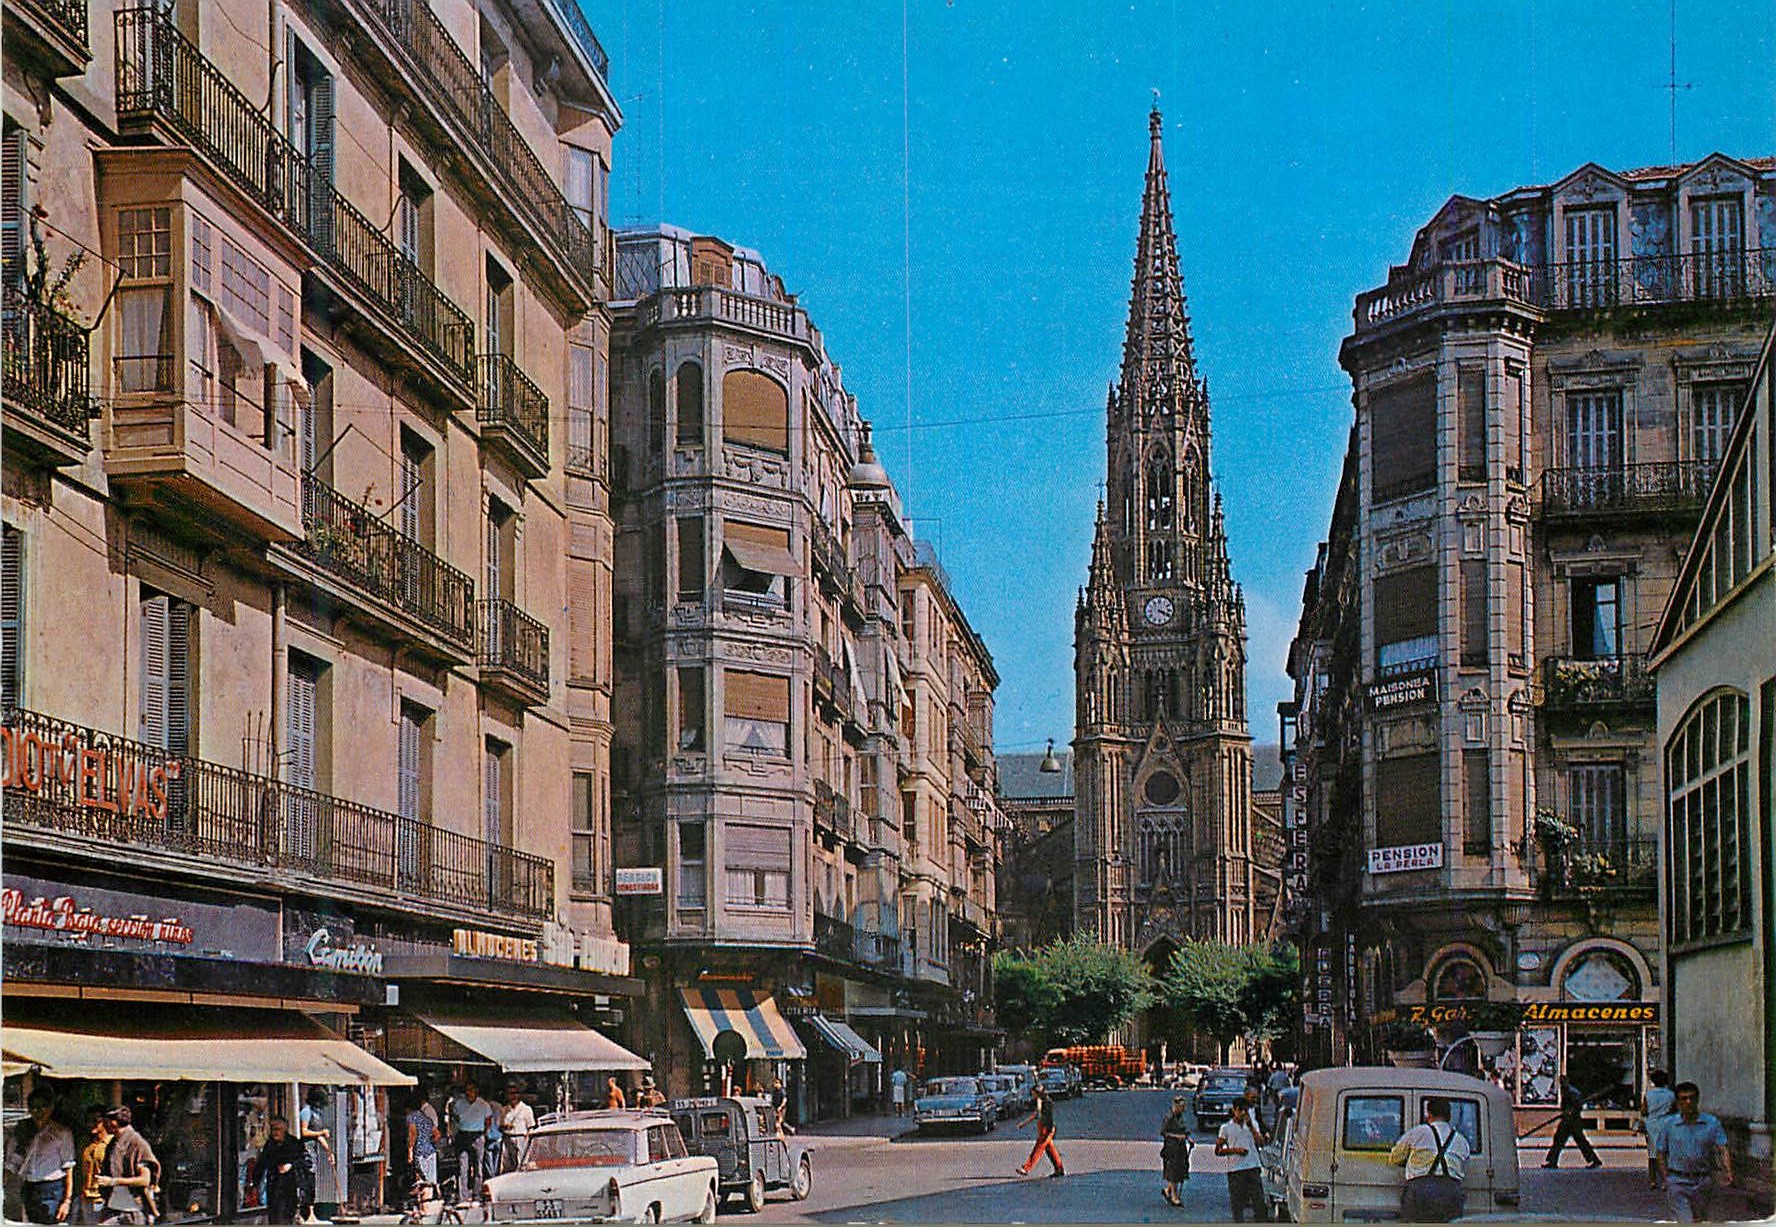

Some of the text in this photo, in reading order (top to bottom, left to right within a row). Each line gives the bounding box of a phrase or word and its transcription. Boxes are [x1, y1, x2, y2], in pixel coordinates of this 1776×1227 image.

[1375, 688, 1425, 708] PENSION
[1371, 845, 1439, 862] PENSION
[1376, 858, 1435, 870] LA PERLA
[1522, 1003, 1656, 1021] Almacenes
